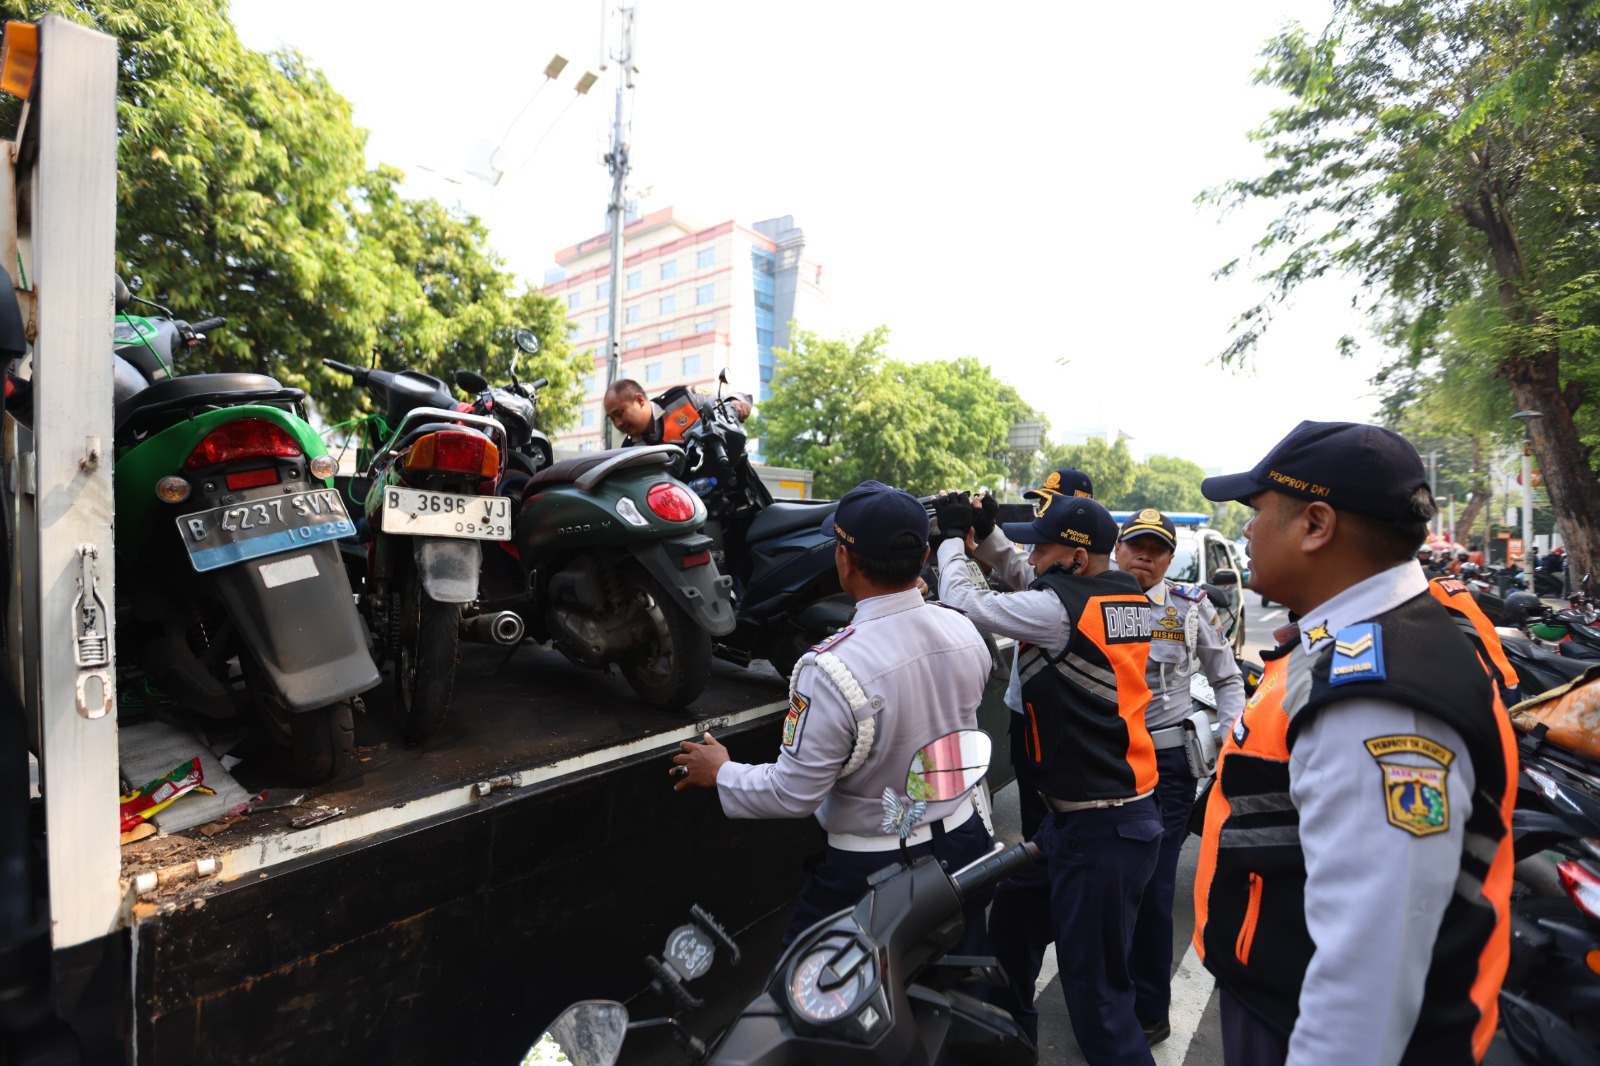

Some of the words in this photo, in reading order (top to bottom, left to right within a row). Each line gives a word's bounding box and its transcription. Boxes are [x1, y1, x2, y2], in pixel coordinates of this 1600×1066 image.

[1270, 470, 1310, 491] PEMPROV
[1310, 484, 1330, 497] DKI
[187, 518, 207, 541] B
[291, 492, 336, 517] SVY
[388, 491, 400, 509] B
[417, 494, 466, 515] 3696
[484, 500, 506, 518] VJ
[1153, 630, 1185, 641] DISHUB
